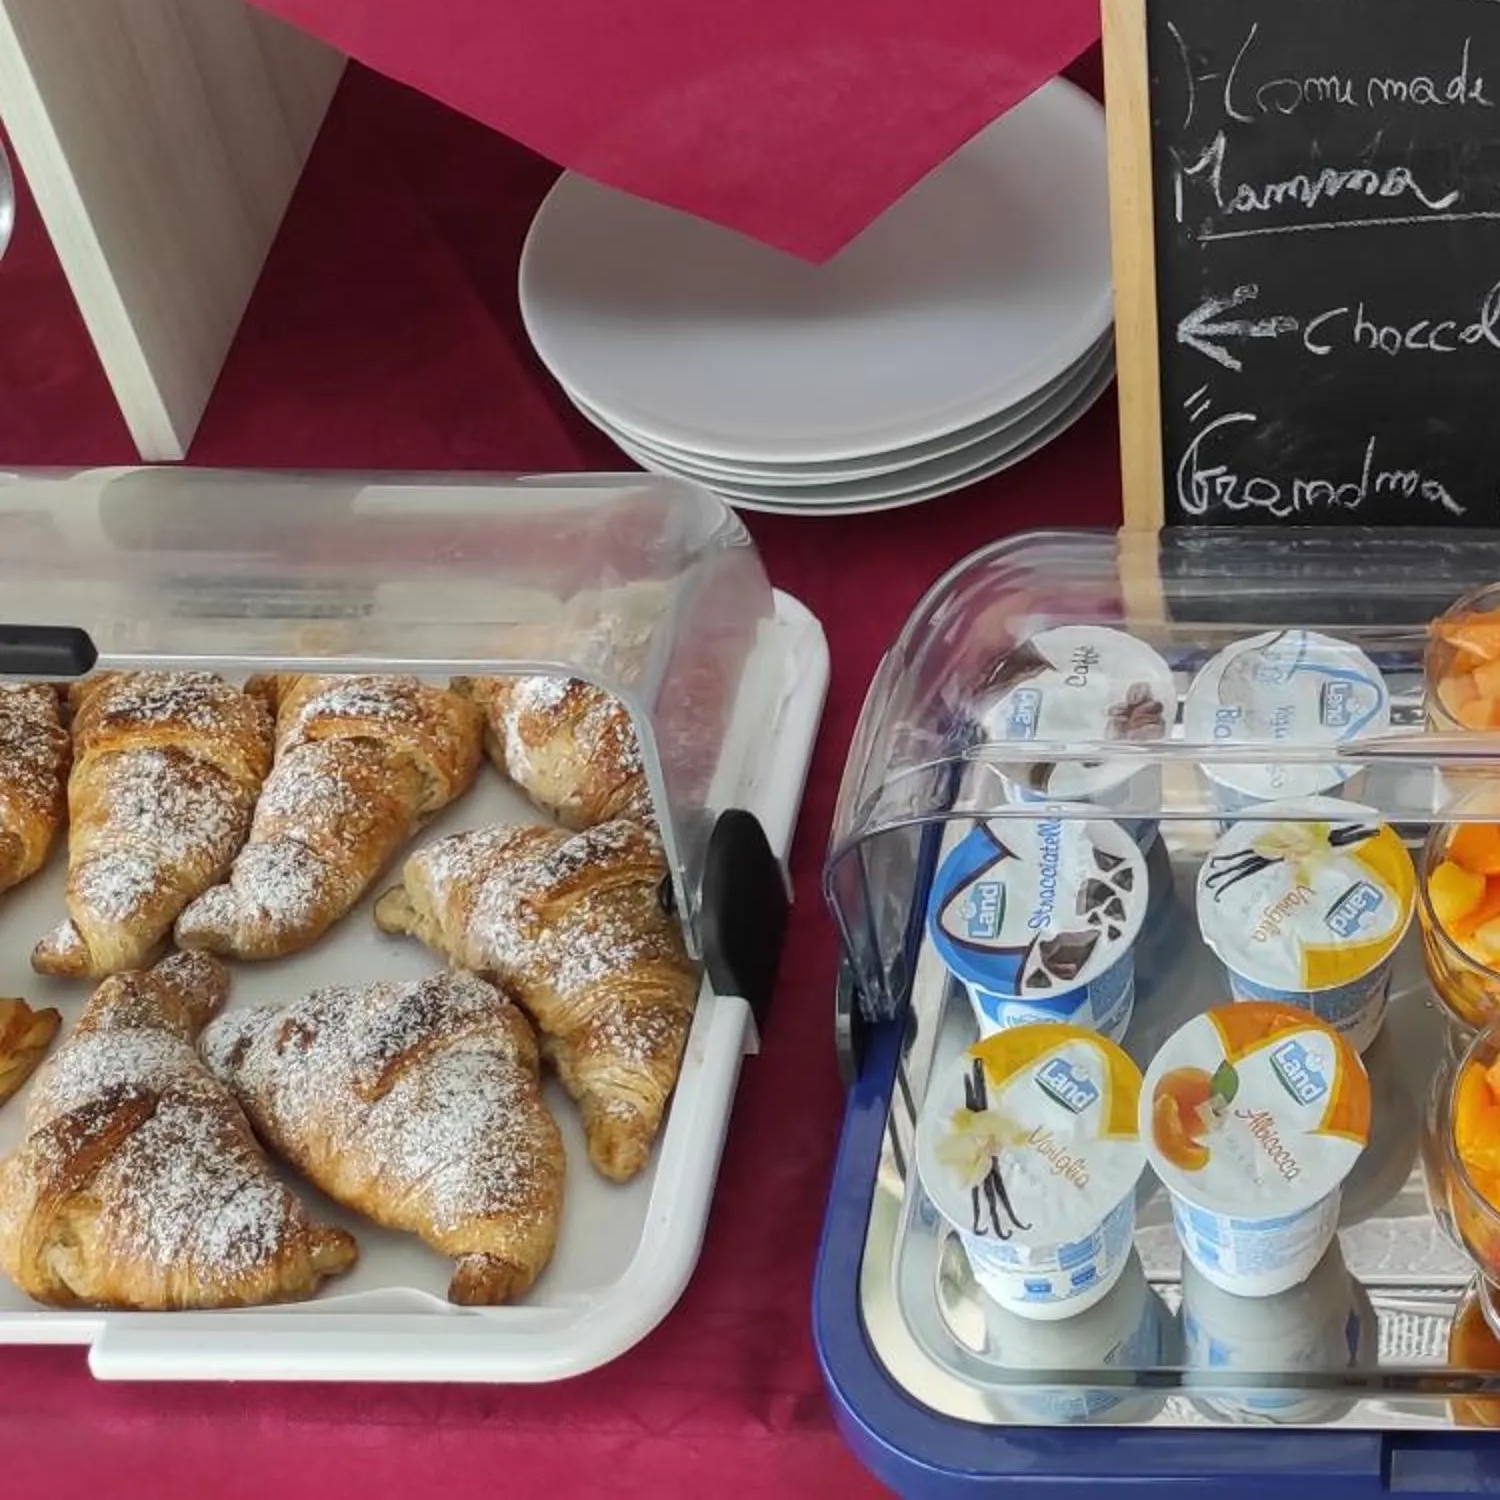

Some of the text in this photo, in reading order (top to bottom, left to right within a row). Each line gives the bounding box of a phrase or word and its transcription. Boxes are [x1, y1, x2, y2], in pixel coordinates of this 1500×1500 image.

[1168, 130, 1459, 224] Mamma
[971, 884, 998, 938] Land
[1251, 884, 1316, 942] Vaniglia
[1329, 884, 1380, 937] Land
[1040, 1059, 1098, 1109] Land
[1275, 1042, 1328, 1101] Land
[1027, 1124, 1090, 1189] Vaniglia
[1234, 1107, 1302, 1181] Albicocca
